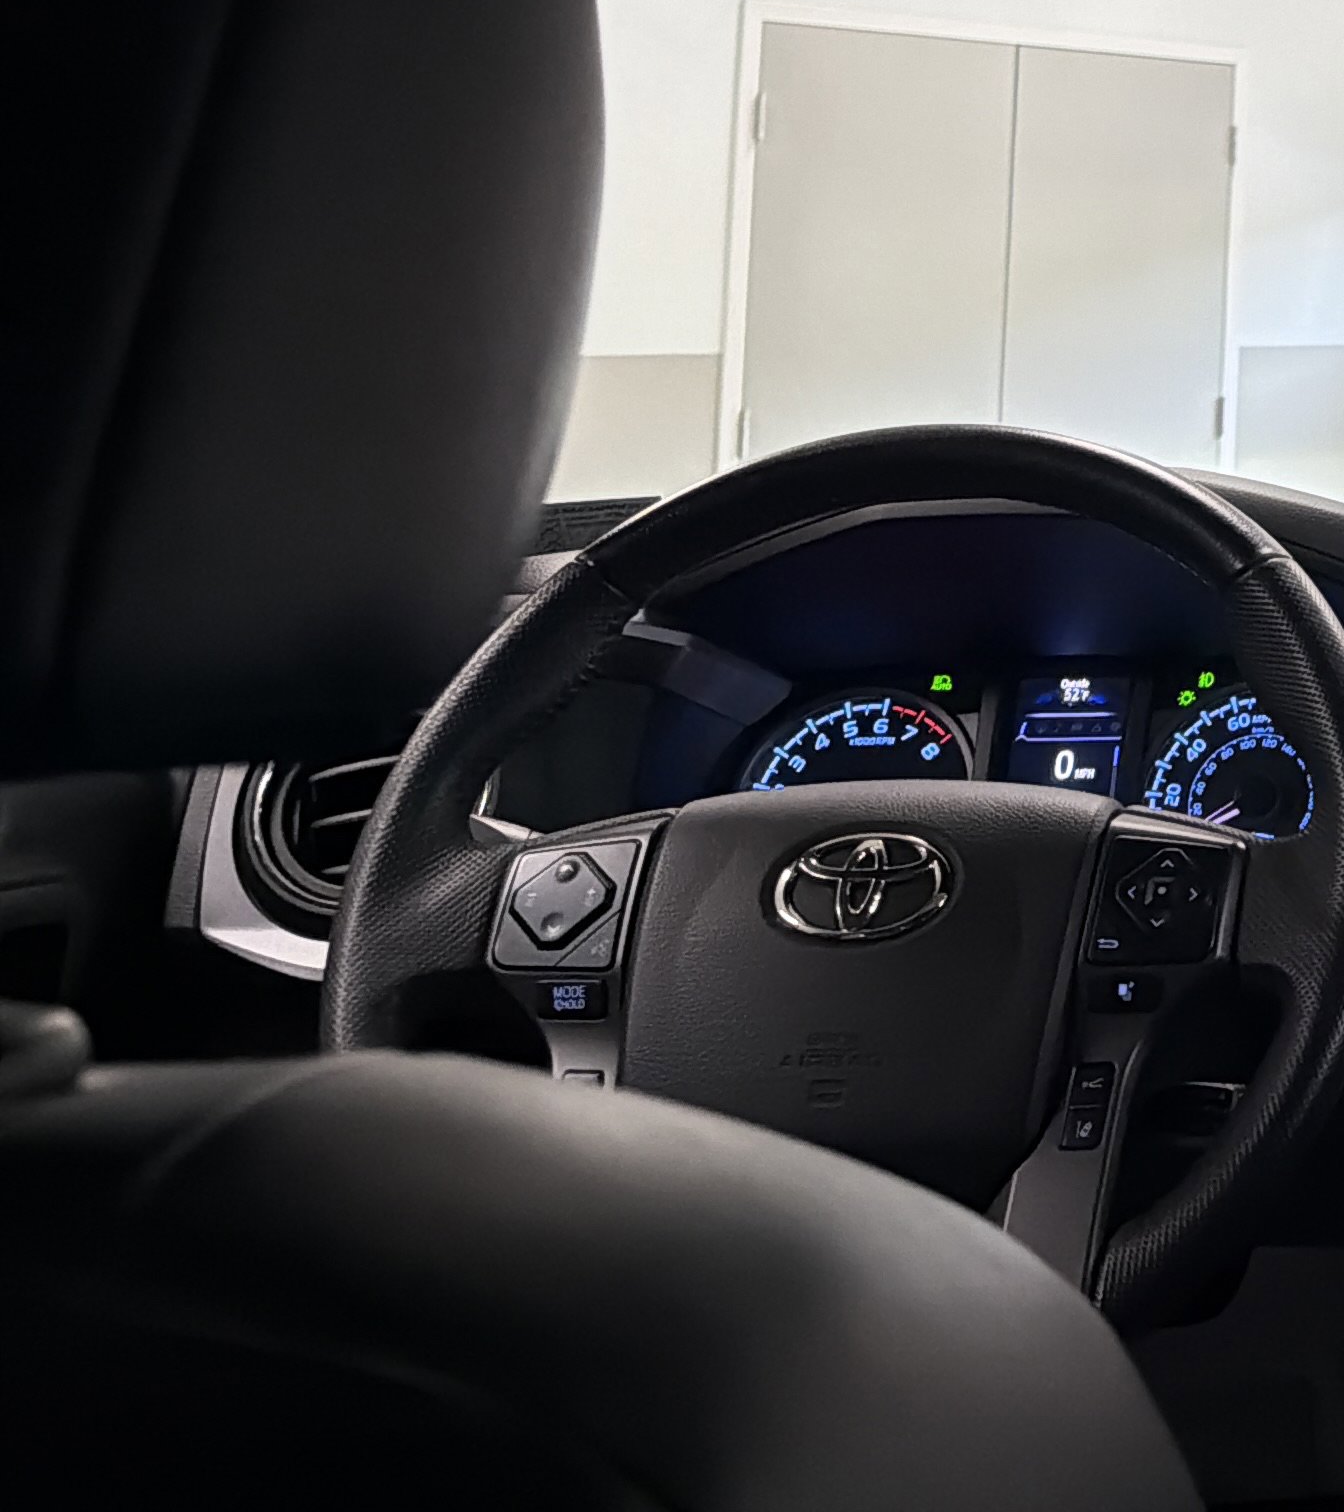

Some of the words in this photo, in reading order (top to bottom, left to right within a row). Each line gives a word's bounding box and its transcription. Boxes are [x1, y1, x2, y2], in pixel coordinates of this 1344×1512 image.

[843, 721, 859, 738] 5
[873, 719, 889, 734] 6
[1227, 713, 1251, 731] 60
[815, 733, 830, 750] 4
[901, 725, 919, 741] 7
[920, 742, 940, 760] 8
[1186, 738, 1207, 762] 40
[788, 754, 806, 772] 3
[1054, 749, 1075, 780] 0
[1074, 768, 1096, 780] MPH
[1164, 783, 1182, 807] 20
[553, 986, 586, 998] MODE
